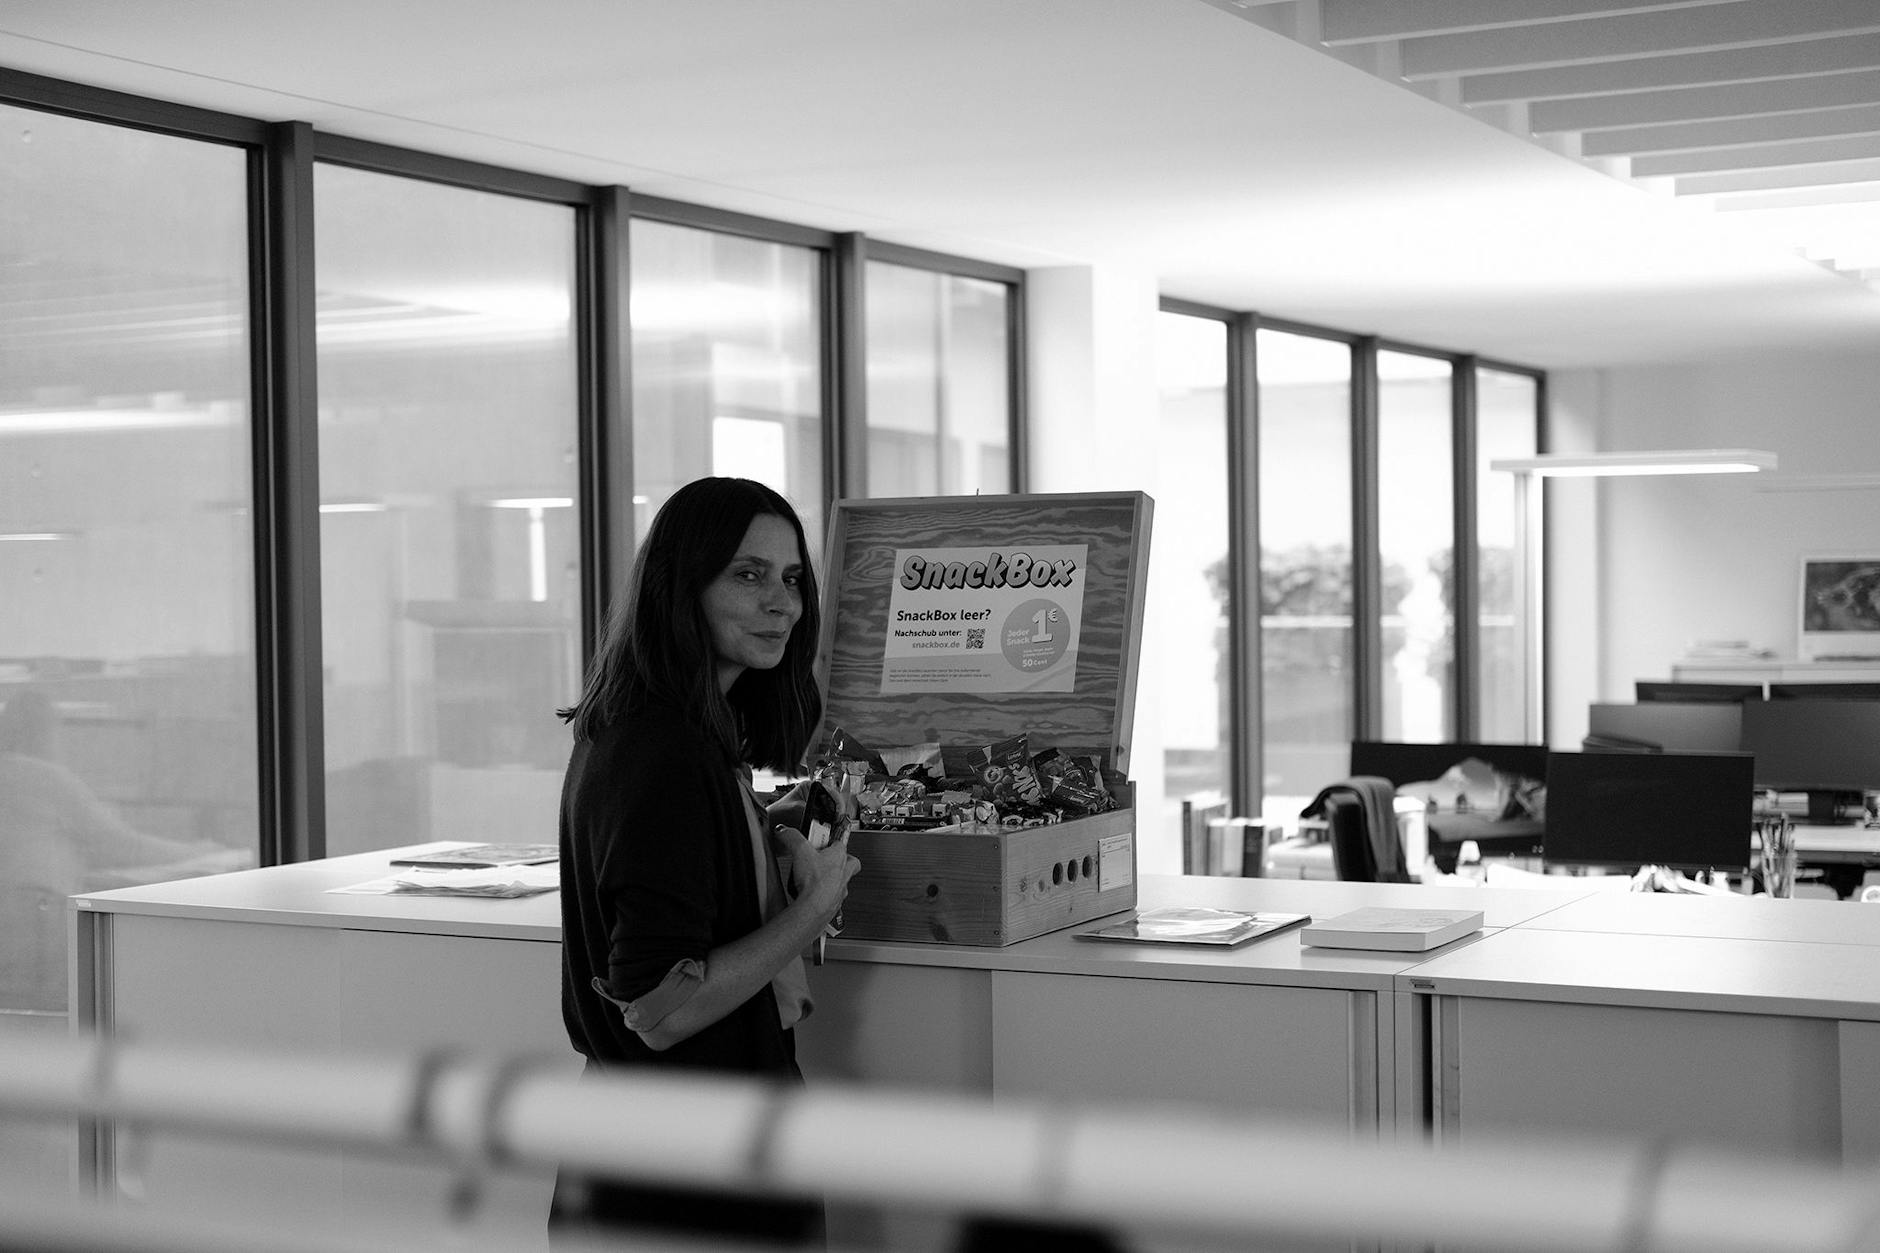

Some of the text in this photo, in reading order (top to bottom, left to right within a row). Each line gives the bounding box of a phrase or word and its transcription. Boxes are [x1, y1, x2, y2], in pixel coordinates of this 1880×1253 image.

[900, 552, 1076, 591] SnackBox
[896, 608, 991, 621] SnackBox leer?
[894, 629, 962, 637] Nachschub unter:
[911, 641, 960, 649] snackbox.de
[1022, 659, 1033, 668] 50
